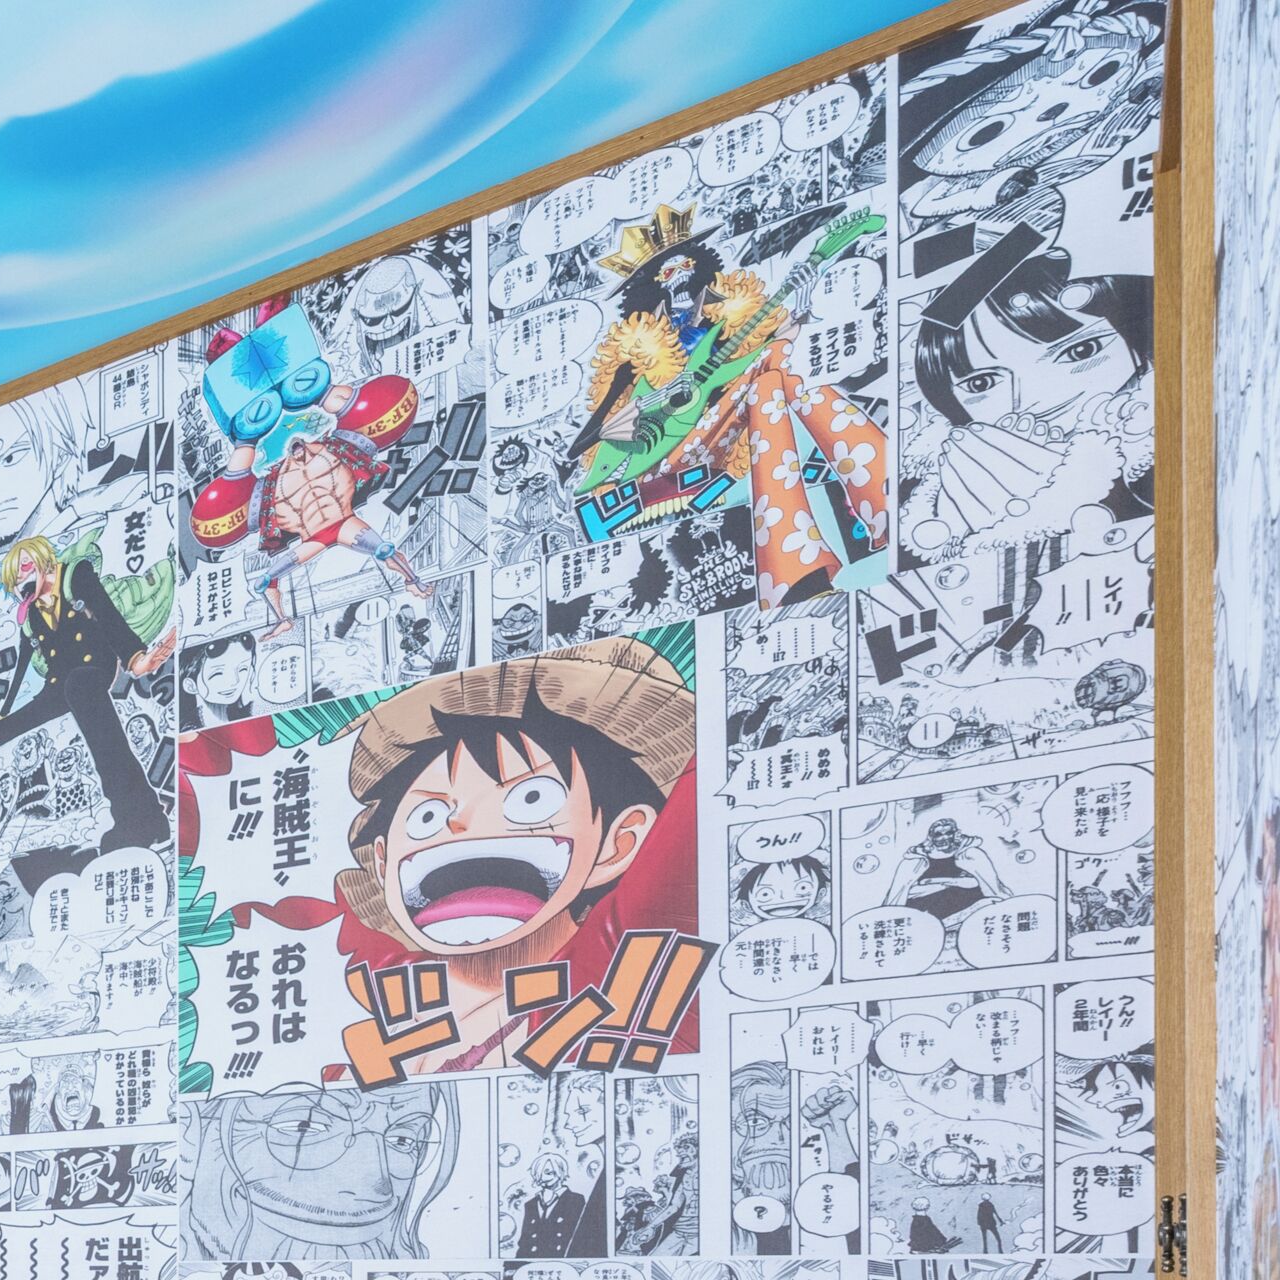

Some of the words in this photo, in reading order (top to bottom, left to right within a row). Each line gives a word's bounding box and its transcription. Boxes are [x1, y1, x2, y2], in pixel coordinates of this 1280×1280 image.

[826, 326, 840, 373] ライブに
[842, 321, 858, 357] 最高の
[1073, 786, 1089, 838] 見に来たが
[1095, 786, 1111, 838] 一応様子を
[755, 831, 803, 850] うん!!
[892, 917, 906, 958] 更に力が
[999, 913, 1012, 954] なさそう
[1016, 909, 1031, 933] 問題
[771, 937, 783, 985] 行きなさい
[872, 918, 887, 969] 洗練されて
[271, 941, 308, 1045] おれは
[812, 1025, 825, 1056] おれは
[1098, 995, 1114, 1043] レイリー
[830, 1024, 841, 1066] レイリー
[114, 1051, 126, 1127] わかっているのか
[1071, 1163, 1089, 1223] ありがとう
[1092, 1163, 1110, 1188] 色々
[1117, 1163, 1134, 1199] 本当に
